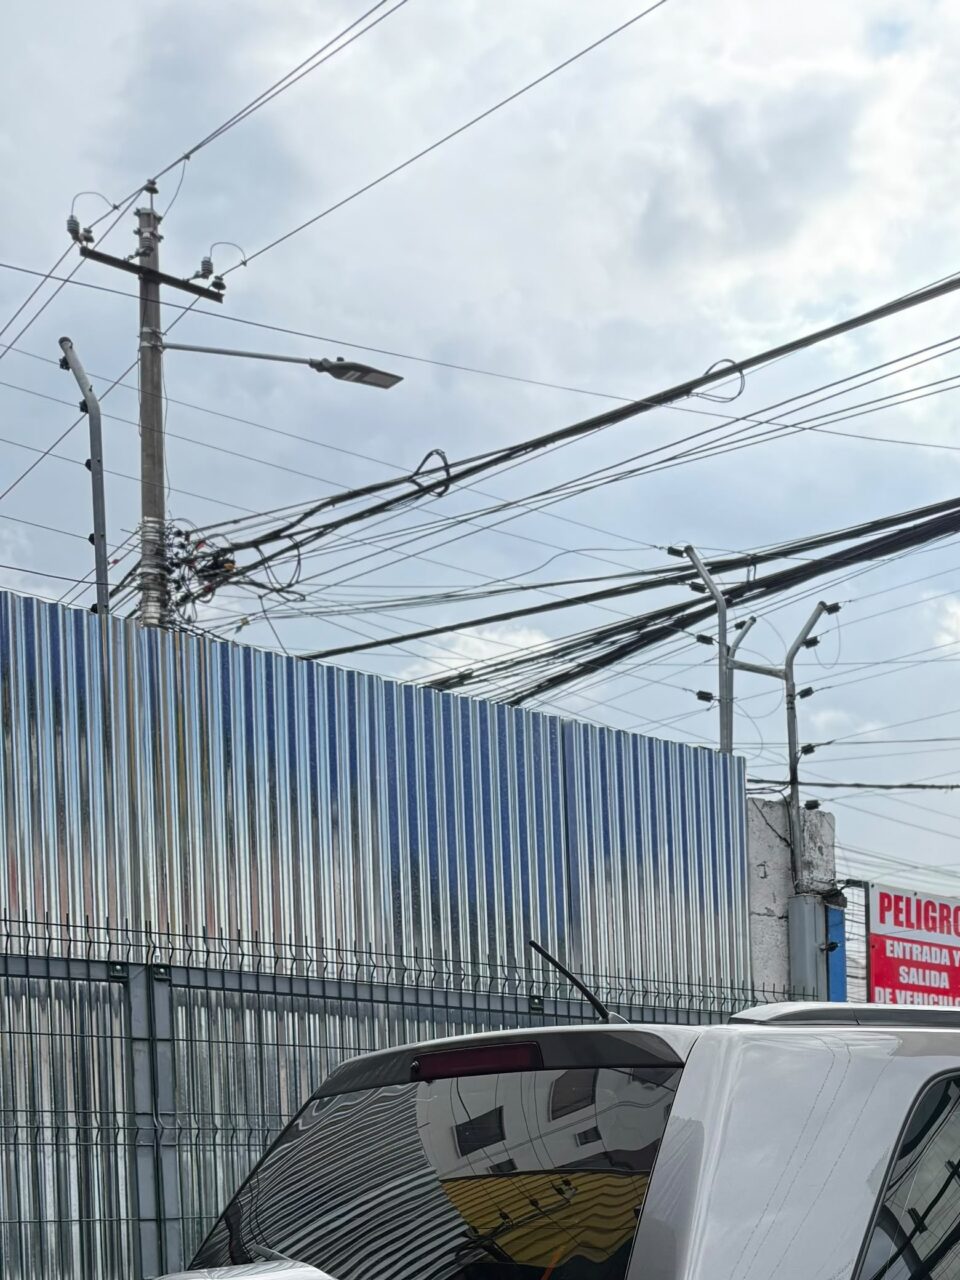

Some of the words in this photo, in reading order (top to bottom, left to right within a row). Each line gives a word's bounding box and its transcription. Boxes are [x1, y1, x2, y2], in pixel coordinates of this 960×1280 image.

[885, 940, 951, 966] ENTRADA
[899, 966, 950, 989] SALIDA
[875, 987, 893, 1004] DE
